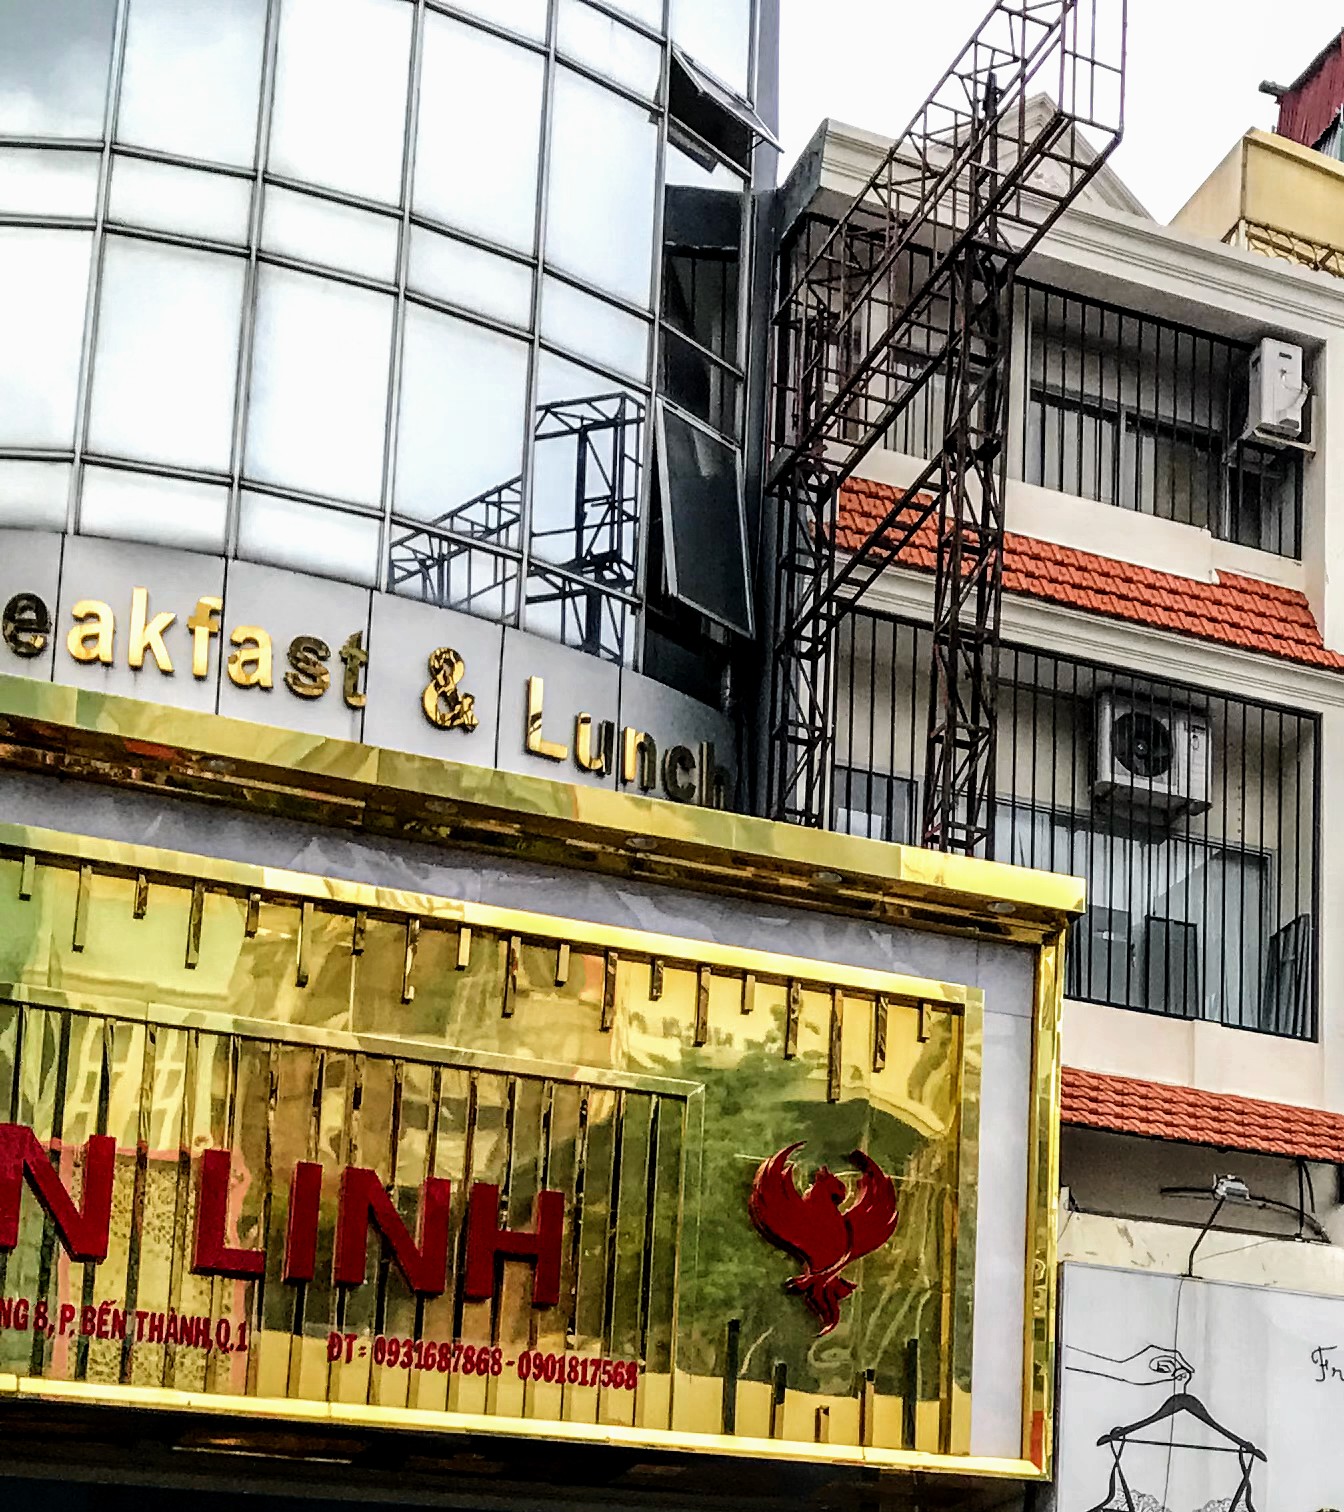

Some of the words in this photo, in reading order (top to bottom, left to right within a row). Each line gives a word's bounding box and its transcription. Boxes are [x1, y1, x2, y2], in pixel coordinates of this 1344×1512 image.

[421, 646, 479, 733] &
[190, 1148, 564, 1308] LINH
[81, 1300, 128, 1340] BẾN
